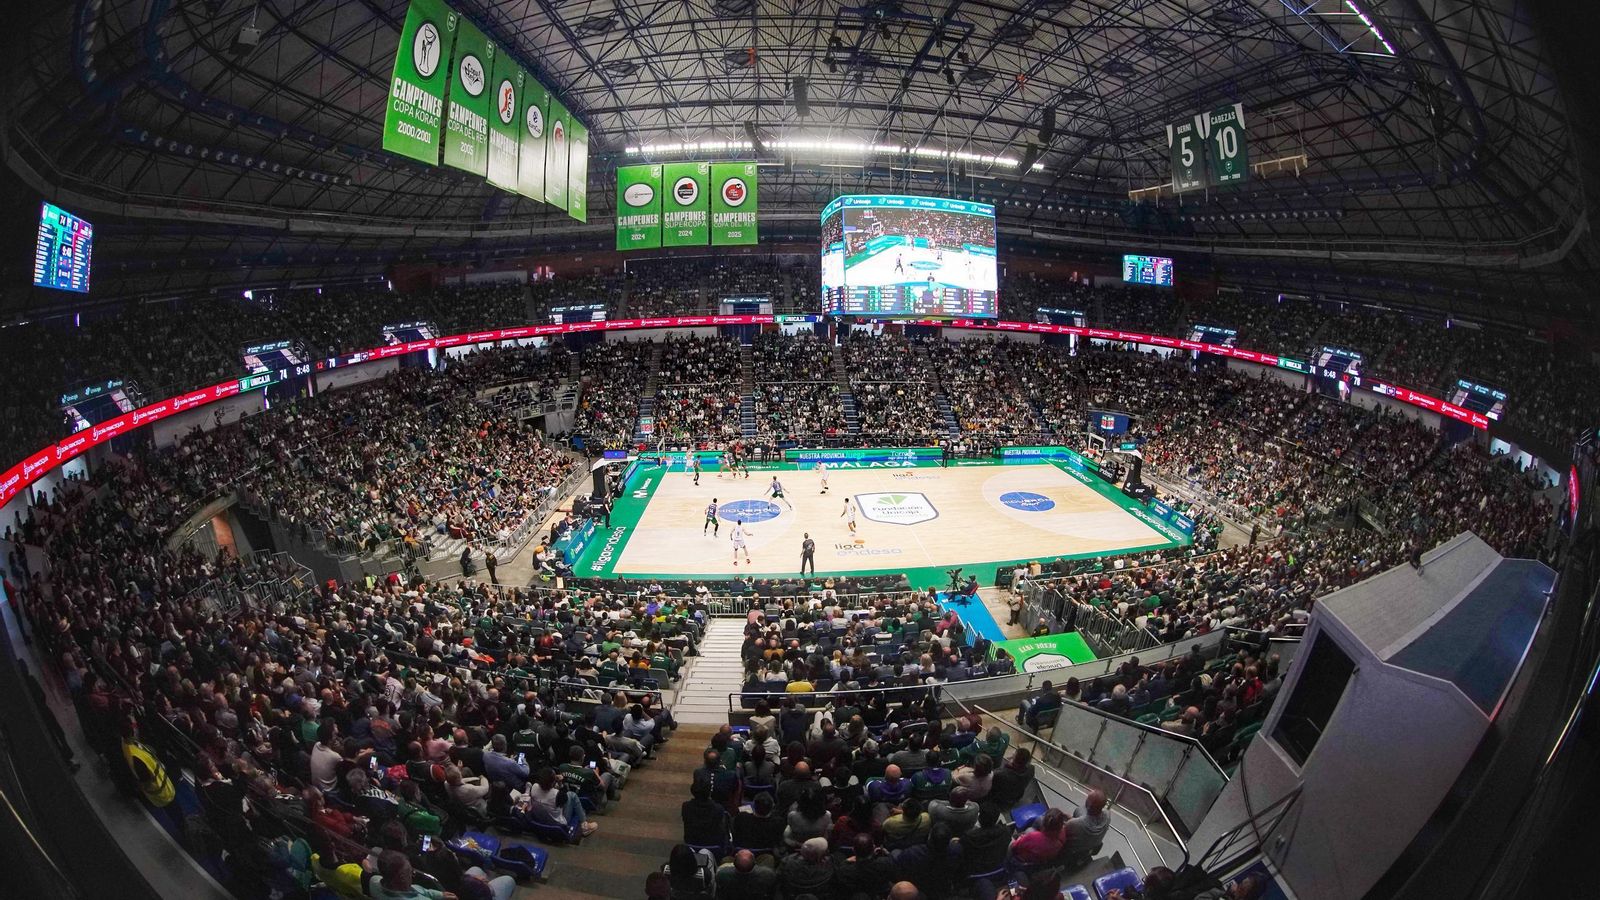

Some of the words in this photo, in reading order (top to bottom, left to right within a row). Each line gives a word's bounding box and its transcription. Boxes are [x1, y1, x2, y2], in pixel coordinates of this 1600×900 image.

[393, 78, 442, 117] CAMPEONES
[394, 101, 414, 117] COPA
[416, 110, 438, 127] KORAC
[450, 102, 487, 134] CAMPEONES
[1211, 112, 1236, 124] CABEZAS
[398, 121, 431, 143] 2000/2001
[448, 120, 463, 133] COPA
[464, 127, 475, 139] DEL
[476, 132, 487, 144] REY
[1215, 126, 1238, 160] 10
[1181, 136, 1194, 166] 5
[618, 214, 659, 225] CAMPEONES
[664, 211, 706, 221] CAMPEONES
[714, 212, 756, 222] CAMPEONES
[280, 369, 288, 380] 74
[1286, 361, 1302, 370] UNICAJA
[1309, 365, 1316, 374] 74
[250, 375, 270, 386] UNICAJA
[591, 526, 626, 572] #ligaendesa
